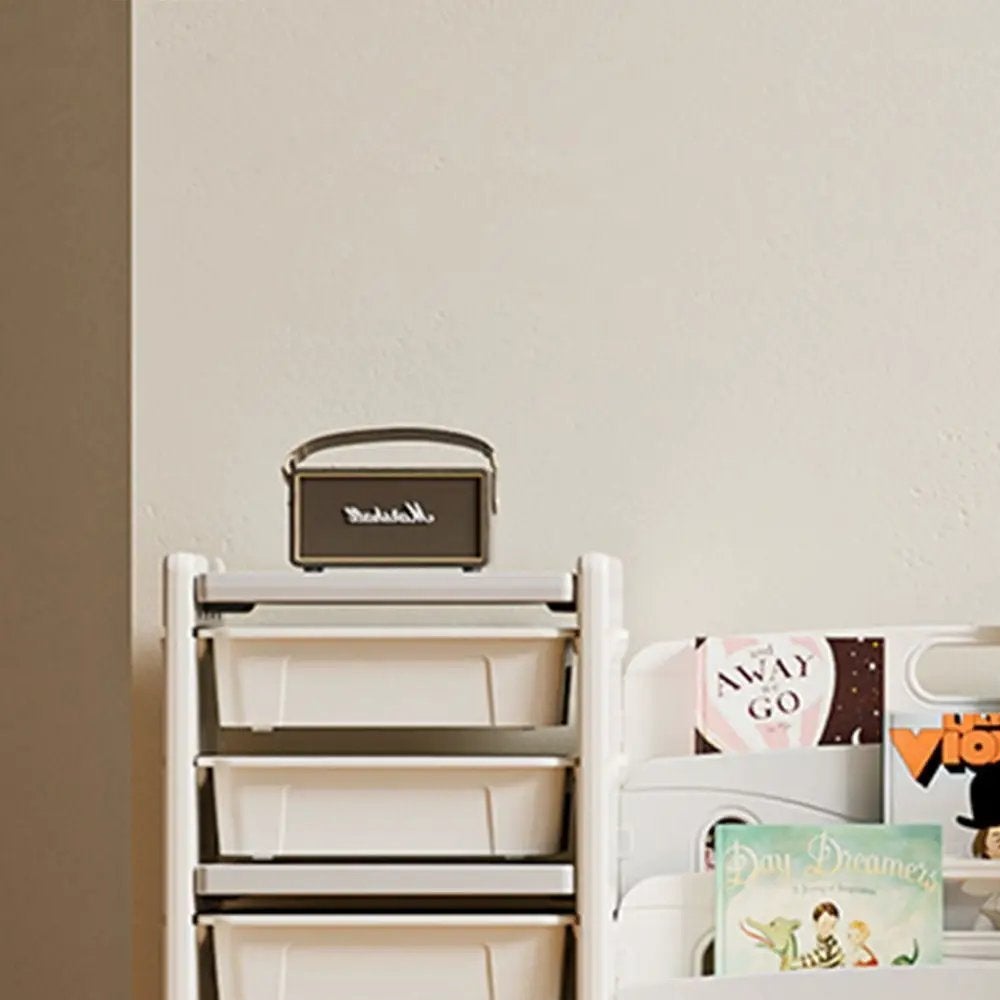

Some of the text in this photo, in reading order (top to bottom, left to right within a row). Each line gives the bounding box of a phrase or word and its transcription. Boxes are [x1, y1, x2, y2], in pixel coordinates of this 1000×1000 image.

[717, 654, 814, 697] AWAY
[748, 690, 800, 721] GO
[722, 830, 938, 893] Day Dreamers
